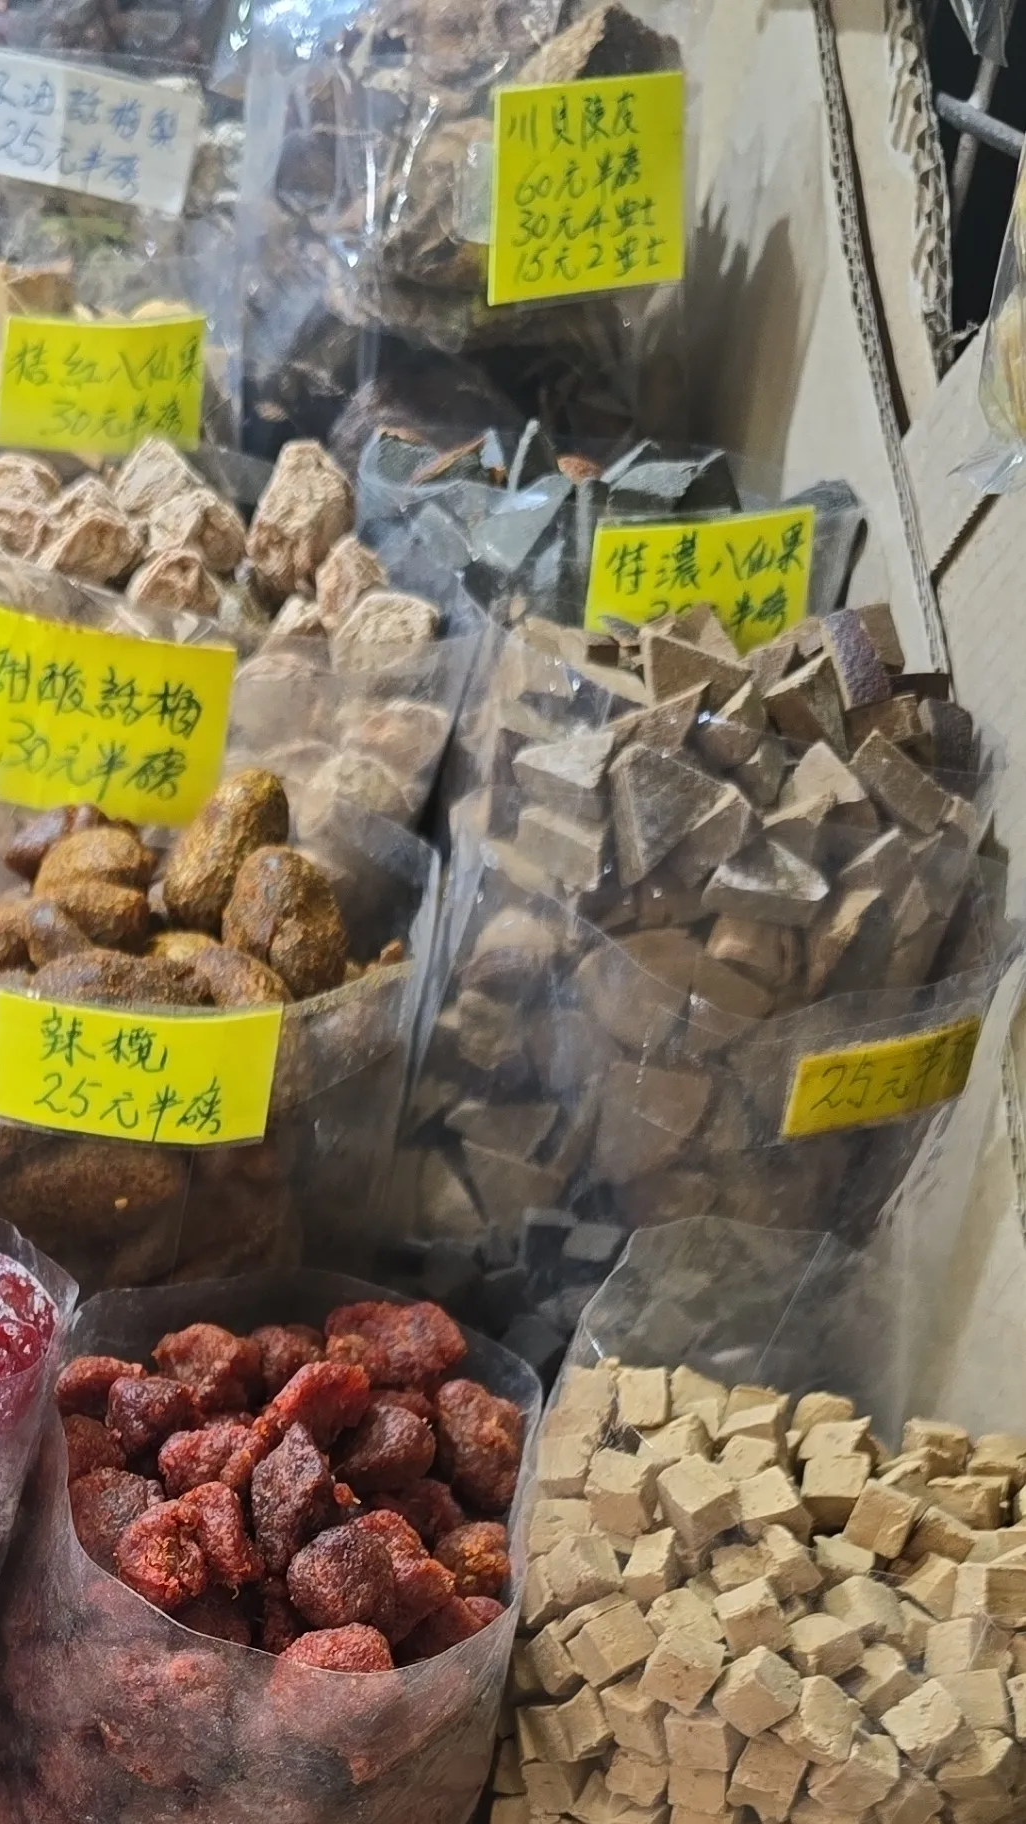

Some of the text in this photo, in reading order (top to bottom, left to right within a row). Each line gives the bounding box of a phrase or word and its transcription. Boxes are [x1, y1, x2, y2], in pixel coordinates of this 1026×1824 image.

[508, 89, 641, 152] 川貝陳皮
[514, 143, 643, 207] 60元半磅
[605, 521, 805, 596] 特濃八仙果
[34, 1072, 222, 1143] 25元半磅
